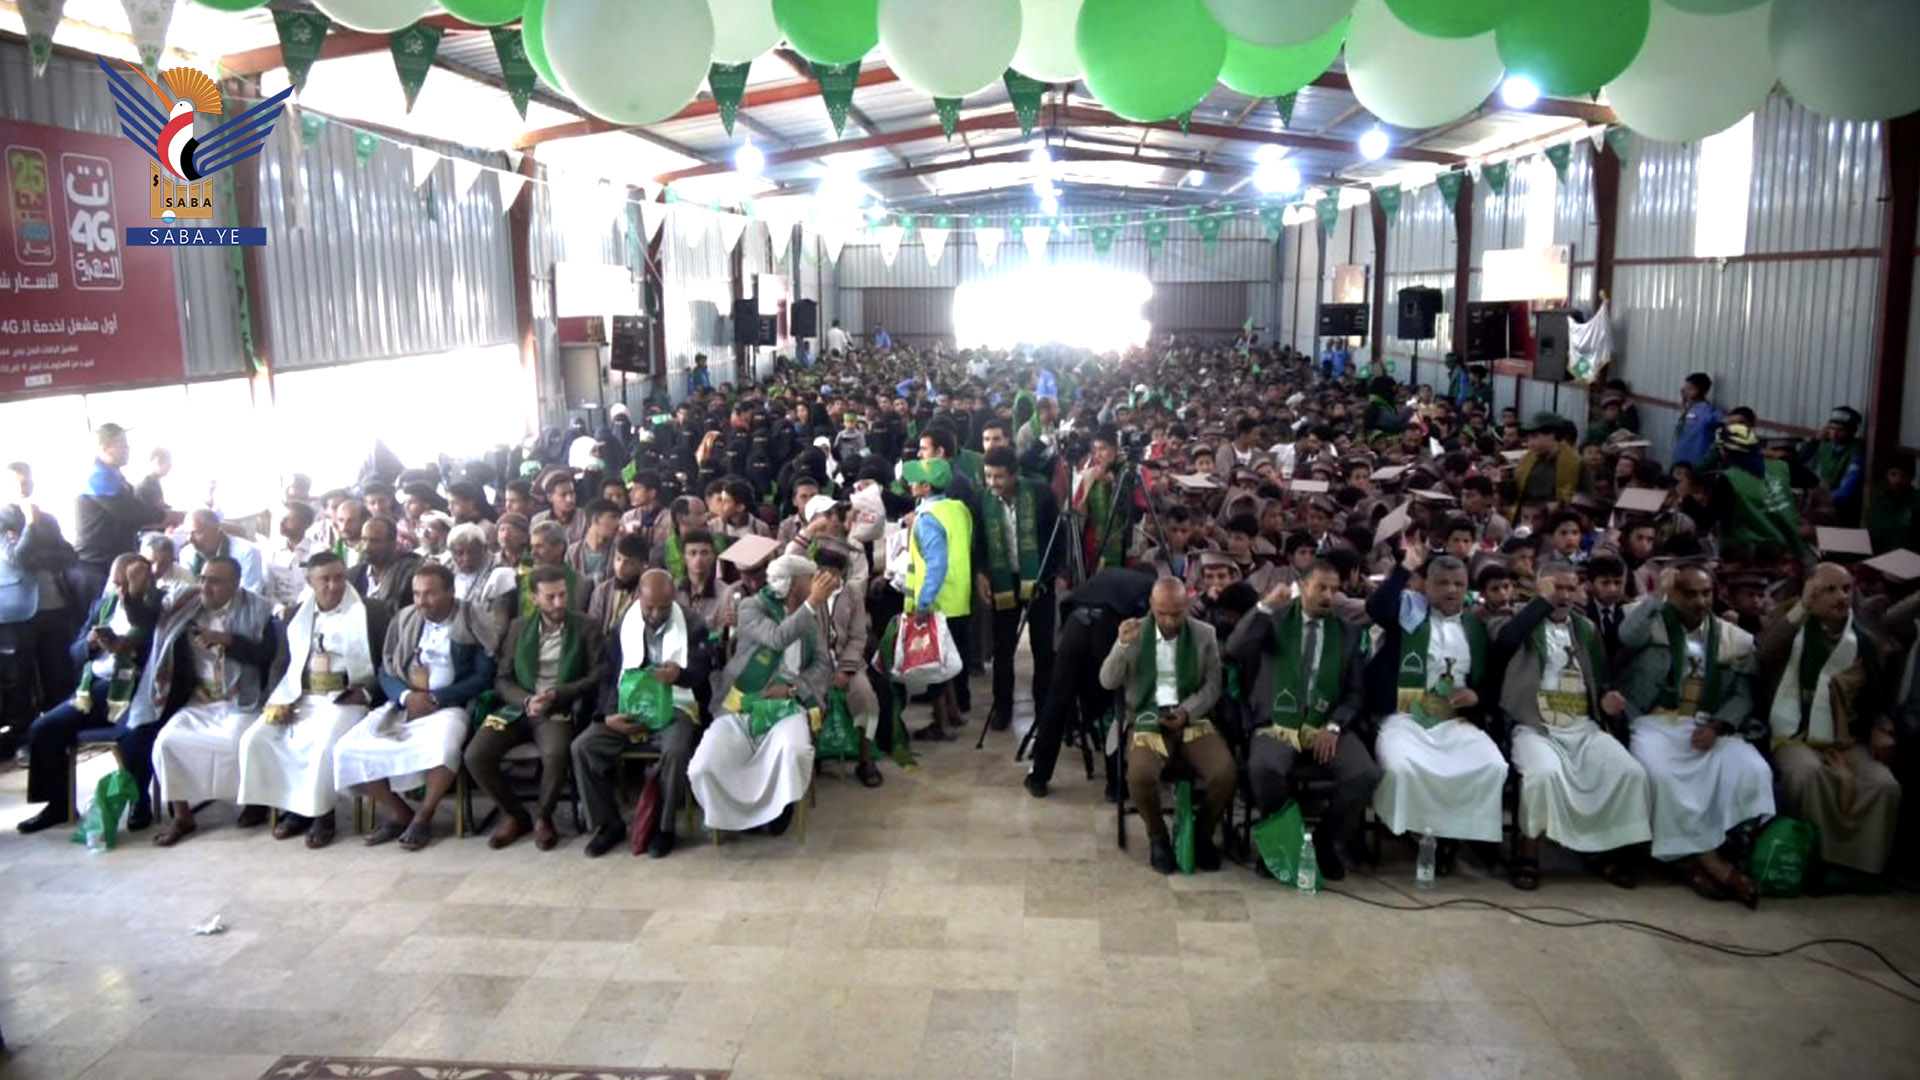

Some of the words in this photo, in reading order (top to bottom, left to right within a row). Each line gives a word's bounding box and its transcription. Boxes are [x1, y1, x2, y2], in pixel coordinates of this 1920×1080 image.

[66, 165, 110, 206] نت
[71, 209, 116, 252] 4G
[1, 319, 19, 334] 4G
